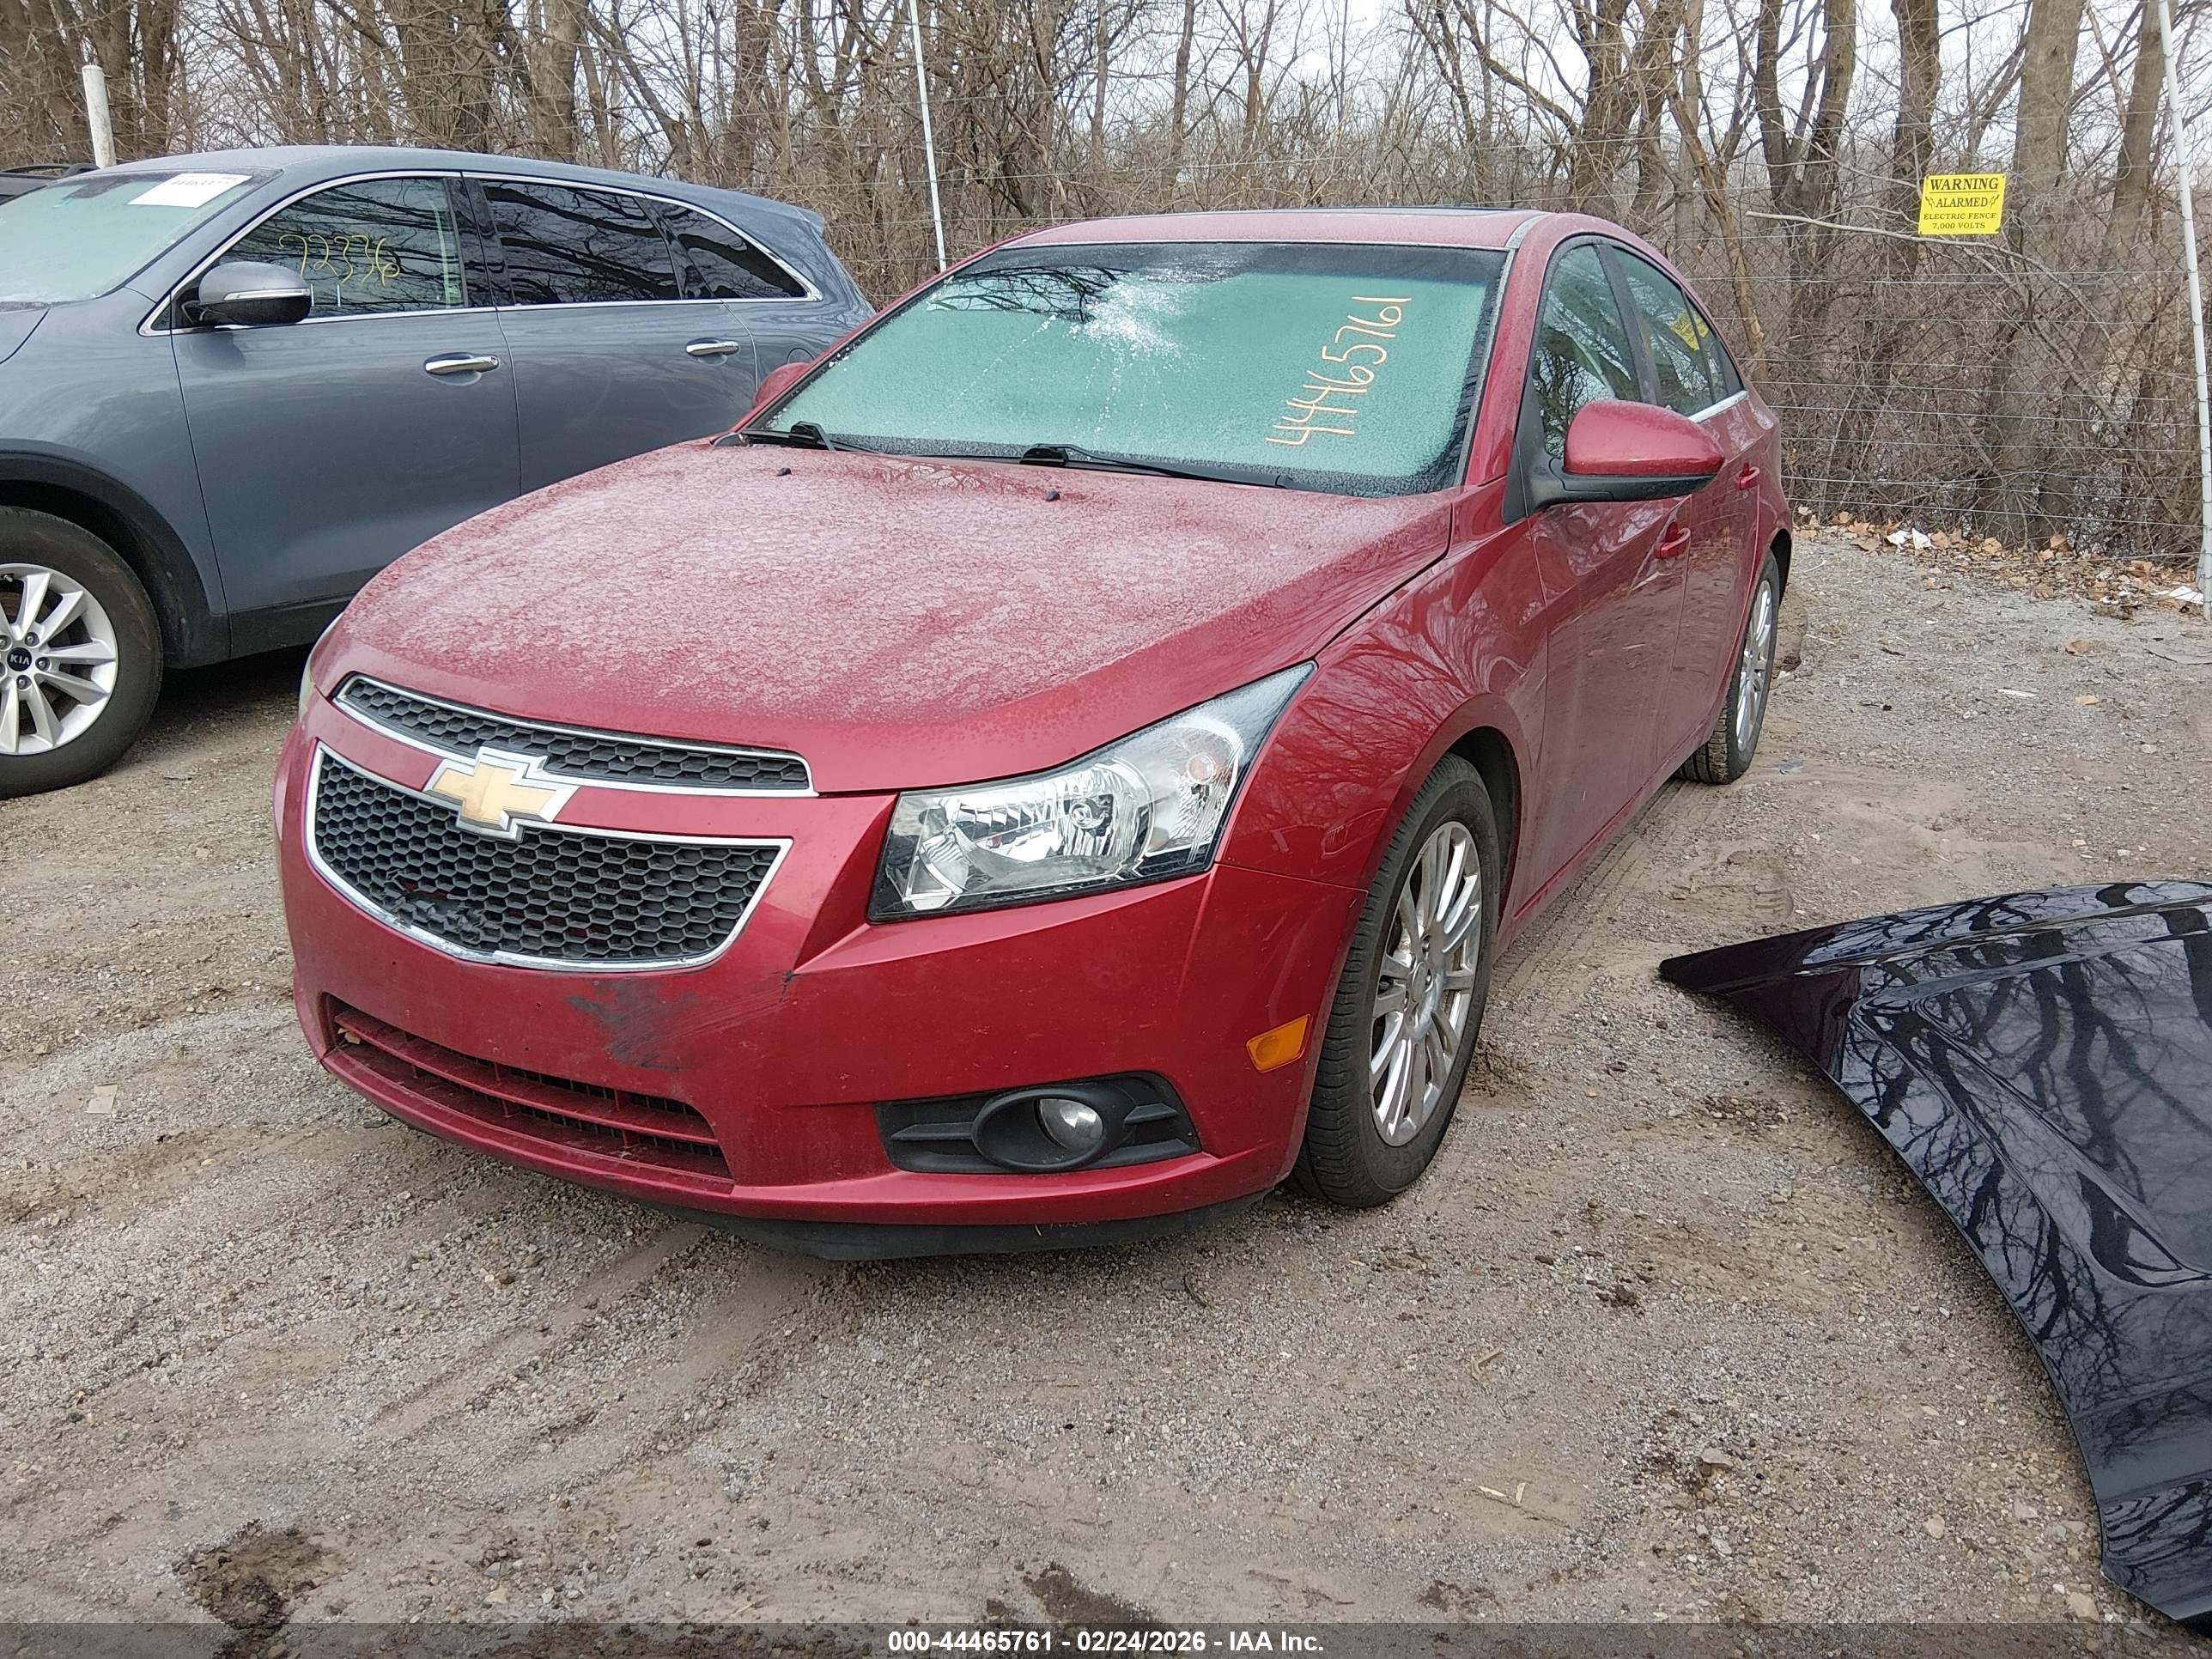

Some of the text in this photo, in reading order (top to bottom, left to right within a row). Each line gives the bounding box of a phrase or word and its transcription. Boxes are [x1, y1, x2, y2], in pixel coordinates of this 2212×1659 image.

[1930, 177, 1999, 191] WARNING
[1936, 198, 1988, 208] ALARMED
[1264, 295, 1413, 446] 44465761
[10, 654, 30, 665] KIA
